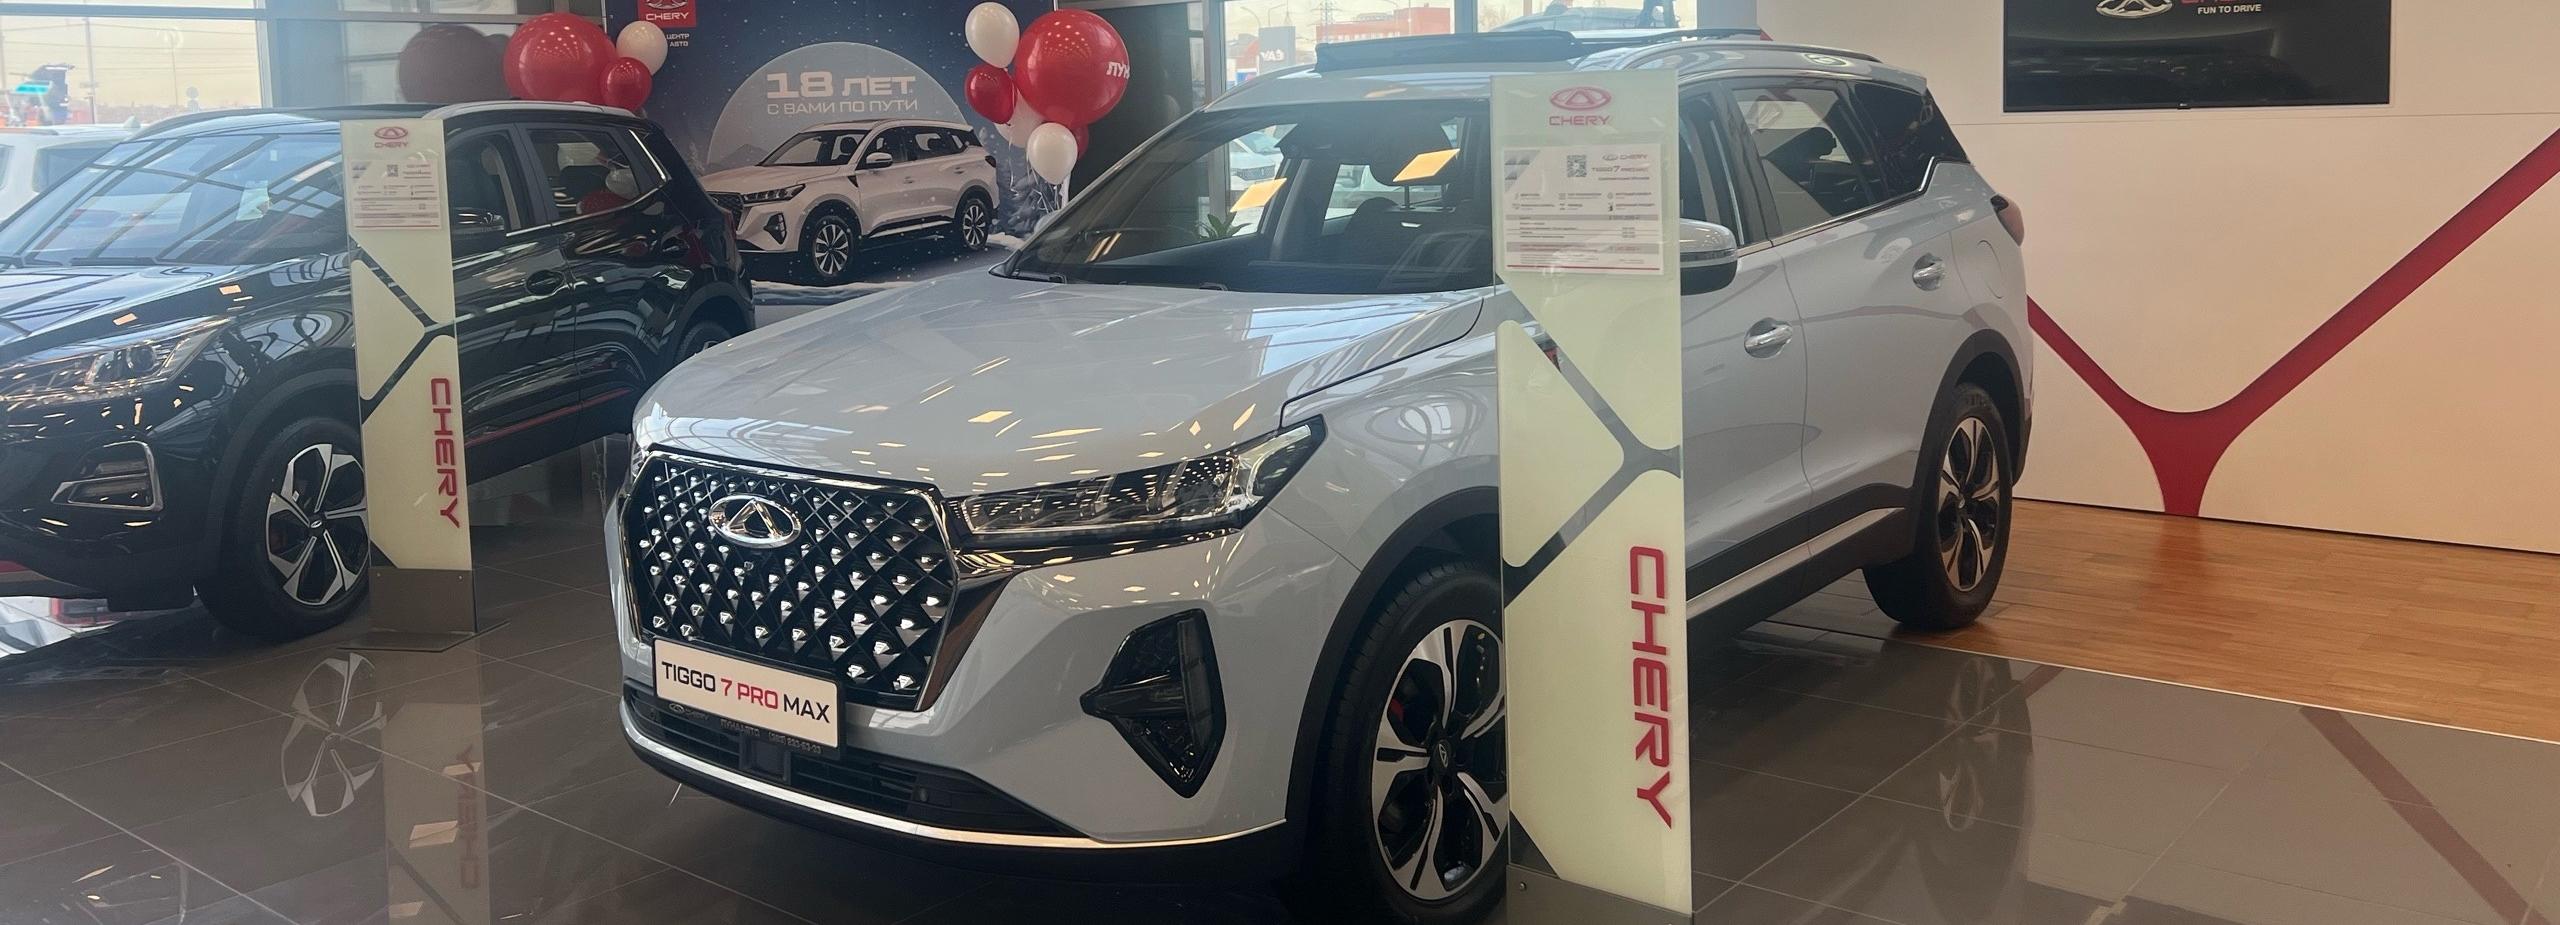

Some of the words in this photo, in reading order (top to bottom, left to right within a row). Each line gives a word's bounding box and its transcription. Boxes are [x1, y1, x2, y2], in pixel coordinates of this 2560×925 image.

[645, 12, 689, 21] CHERY
[2197, 7, 2217, 15] FUN
[2233, 4, 2262, 13] DRIVE
[767, 71, 833, 98] 18
[842, 75, 916, 97] ЛЕТ
[767, 104, 779, 115] С
[784, 102, 835, 115] ВАМИ
[840, 101, 865, 113] ПО
[870, 100, 918, 113] ПУТИ
[1549, 115, 1610, 126] CHERY
[431, 378, 460, 529] CHERY
[661, 661, 716, 693] TIGGO
[720, 678, 732, 697] 7
[737, 682, 779, 710] PRO
[783, 693, 830, 724] MAX
[1629, 546, 1672, 830] CHERY
